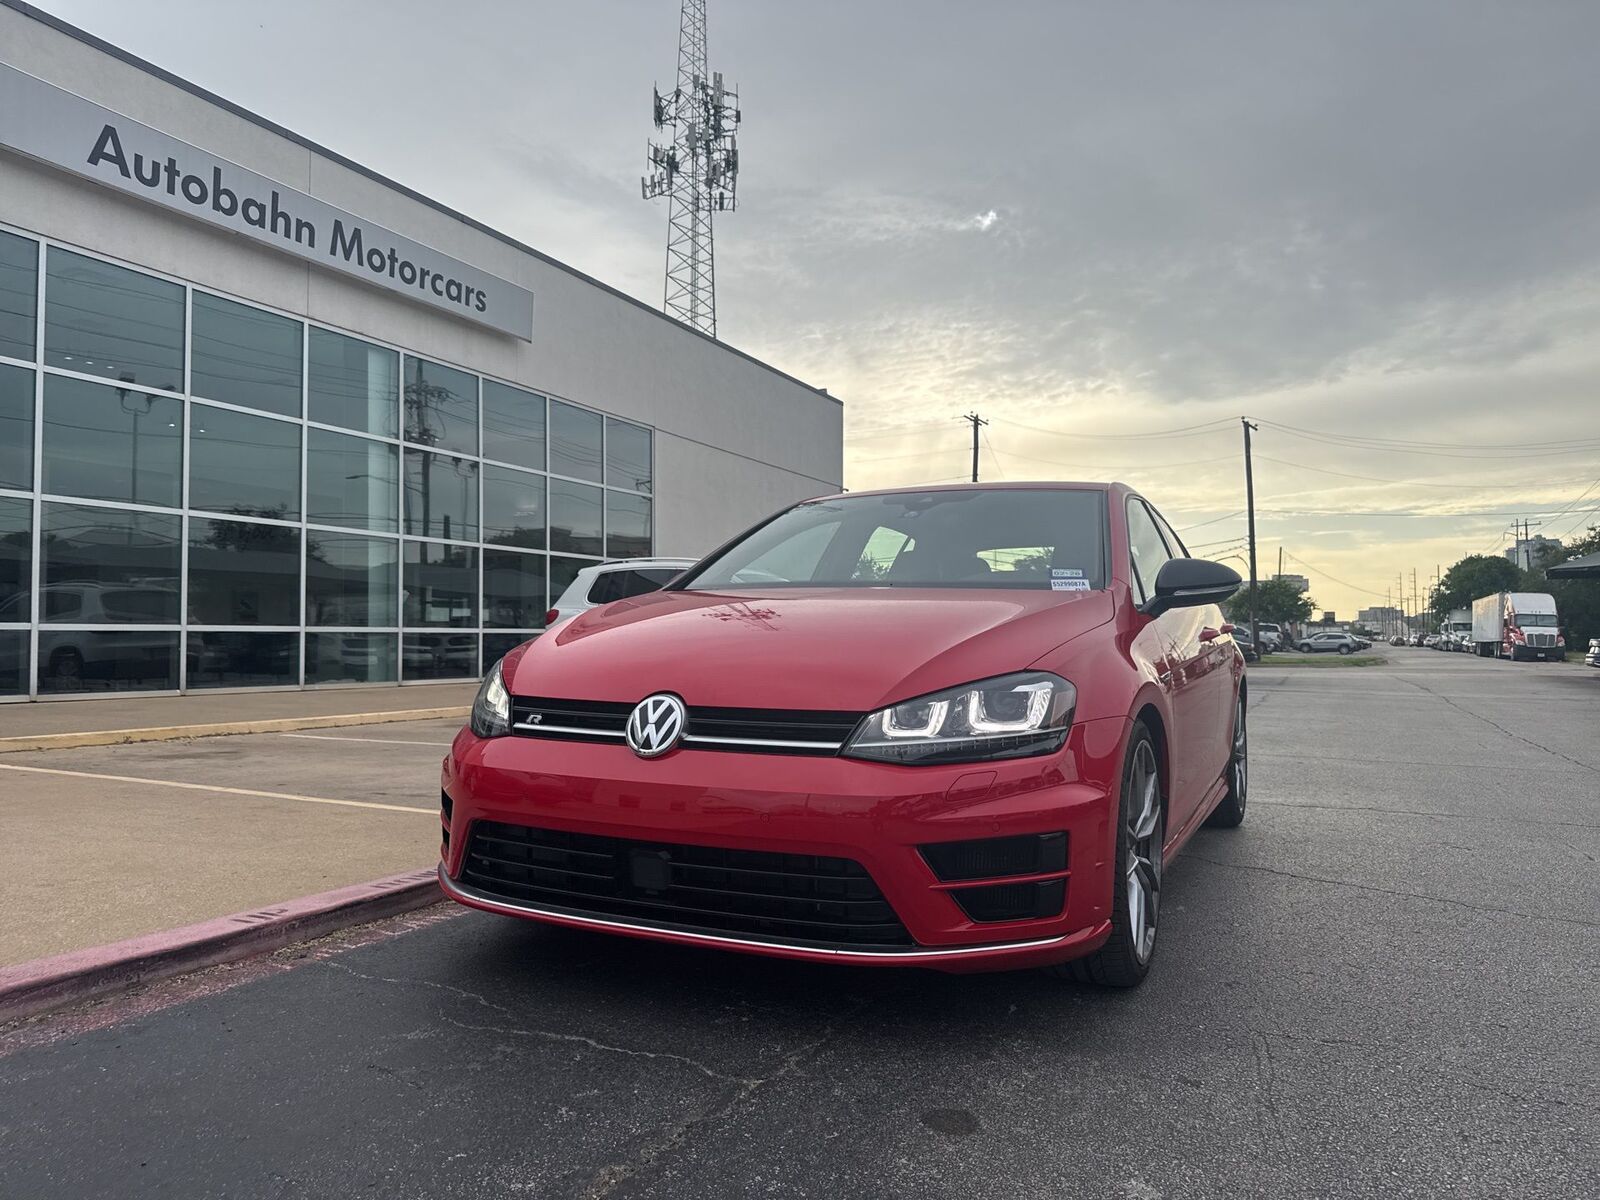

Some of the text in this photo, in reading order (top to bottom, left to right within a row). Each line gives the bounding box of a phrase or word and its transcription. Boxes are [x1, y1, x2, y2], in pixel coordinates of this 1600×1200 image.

[87, 124, 487, 313] Autobahn Motorcars
[526, 713, 543, 725] R
[627, 695, 685, 755] VW
